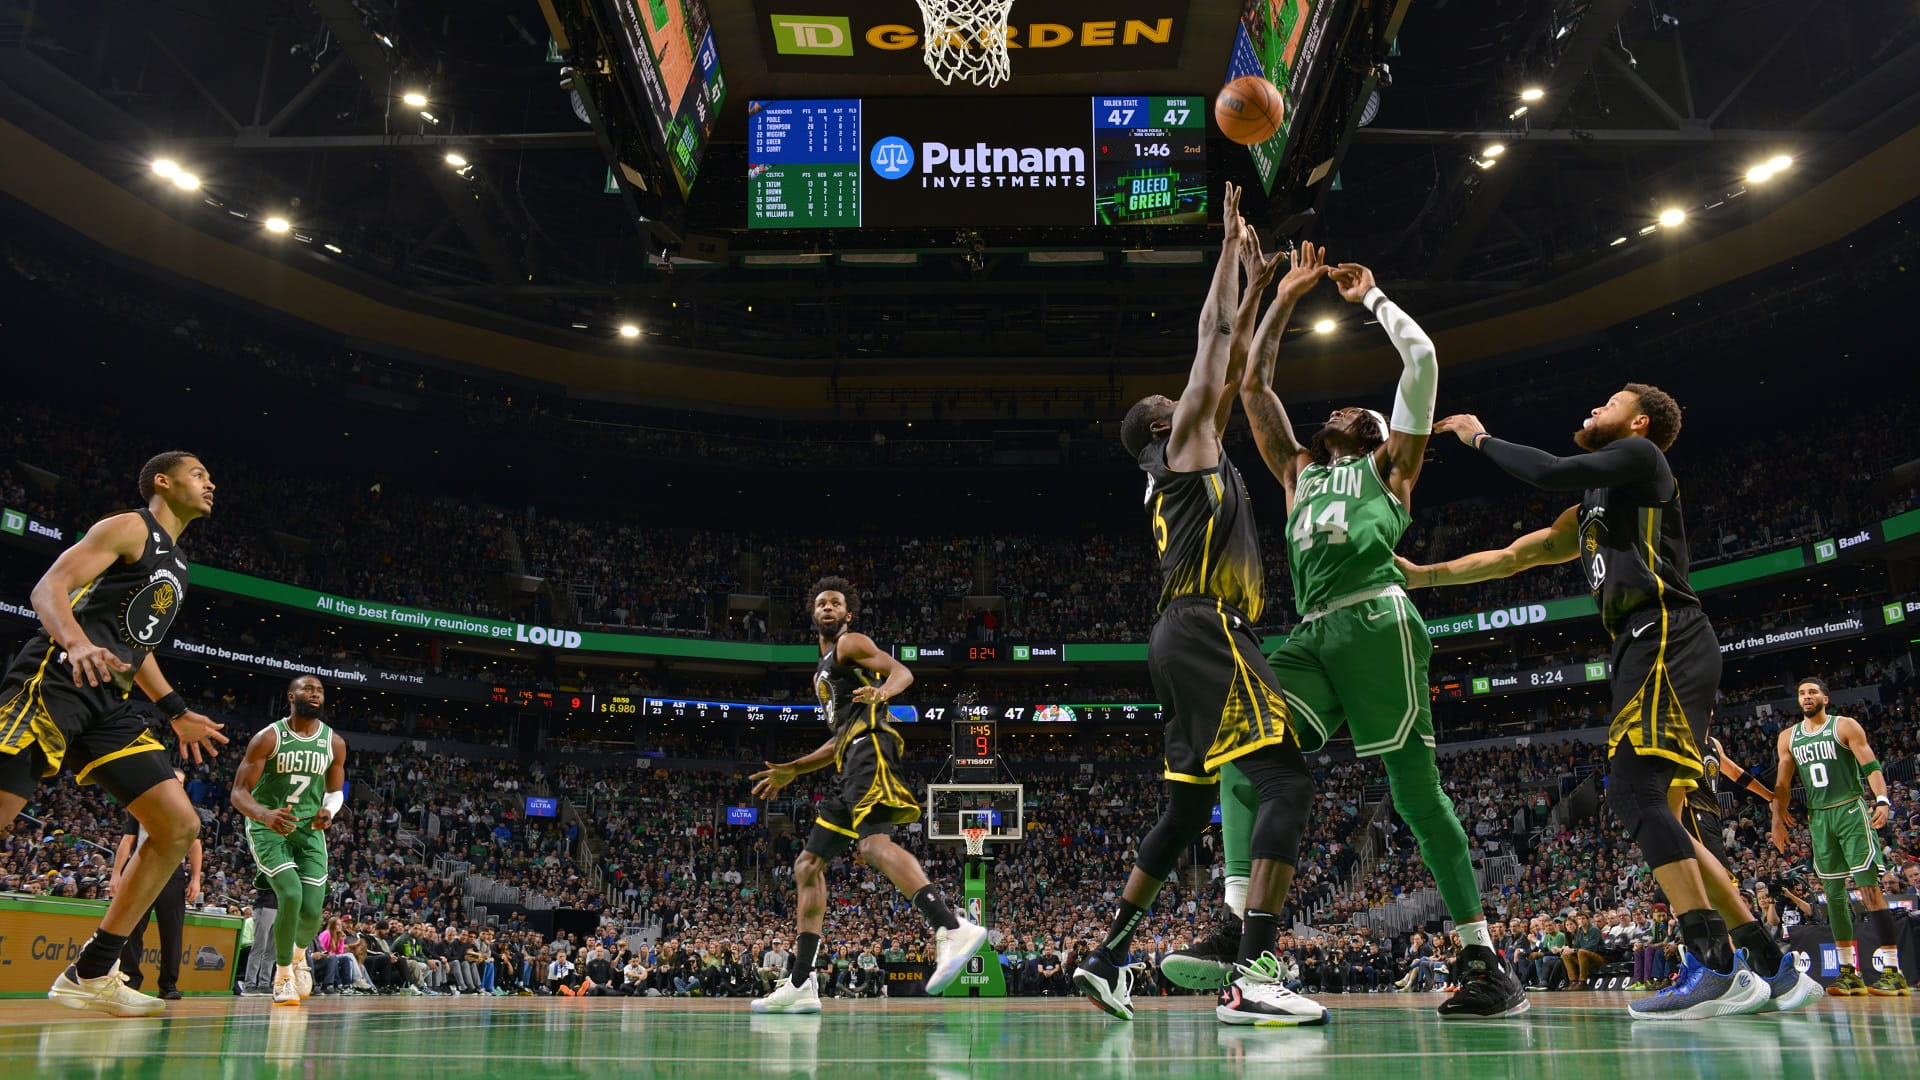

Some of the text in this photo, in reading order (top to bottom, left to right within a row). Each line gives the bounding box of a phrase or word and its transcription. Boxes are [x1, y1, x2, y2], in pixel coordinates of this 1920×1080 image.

[780, 18, 1173, 50] TD GARDEN
[1108, 110, 1190, 125] 47 47
[922, 142, 1085, 174] Putnam
[1101, 144, 1201, 156] 9 1:46 2nd
[922, 175, 1086, 188] INVESTMENTS
[1132, 178, 1168, 194] BLEED
[1129, 192, 1171, 211] GREEN
[6, 512, 63, 540] TD Bank
[1292, 501, 1348, 552] 44
[1817, 530, 1870, 558] TD Bank
[18, 606, 36, 618] fan
[316, 596, 582, 649] All the best family reunions get LOUD
[1453, 604, 1546, 633] get LOUD
[138, 614, 159, 640] 3
[1736, 638, 1746, 650] of
[1747, 636, 1764, 648] the
[1766, 631, 1803, 644] Boston
[1804, 626, 1823, 637] fan
[1824, 618, 1863, 634] family.
[1886, 606, 1902, 620] TD
[173, 639, 205, 653] Proud
[206, 645, 217, 656] to
[218, 647, 231, 658] be
[232, 651, 253, 664] part
[254, 655, 266, 666] of
[266, 656, 282, 668] the
[283, 660, 316, 674] Boston
[317, 665, 332, 676] fan
[334, 667, 368, 682] family.
[381, 672, 399, 681] PLAY
[409, 675, 423, 683] THE
[904, 648, 916, 658] TD
[1016, 648, 1028, 658] TD
[1476, 680, 1488, 690] TD
[1492, 676, 1518, 687] Bank
[1530, 670, 1563, 685] 8:24
[1589, 666, 1603, 677] TD
[571, 698, 580, 708] 9
[601, 704, 606, 712] $
[925, 708, 1024, 720] 47 47
[779, 714, 799, 722] 17/47
[970, 724, 990, 736] 1:45
[976, 736, 988, 756] 9
[1793, 740, 1838, 766] BOSTON
[276, 750, 328, 776] BOSTON
[1810, 762, 1829, 788] 0
[286, 774, 312, 804] 7
[32, 935, 64, 960] Car
[1824, 950, 1837, 969] NBA
[979, 976, 989, 984] APP
